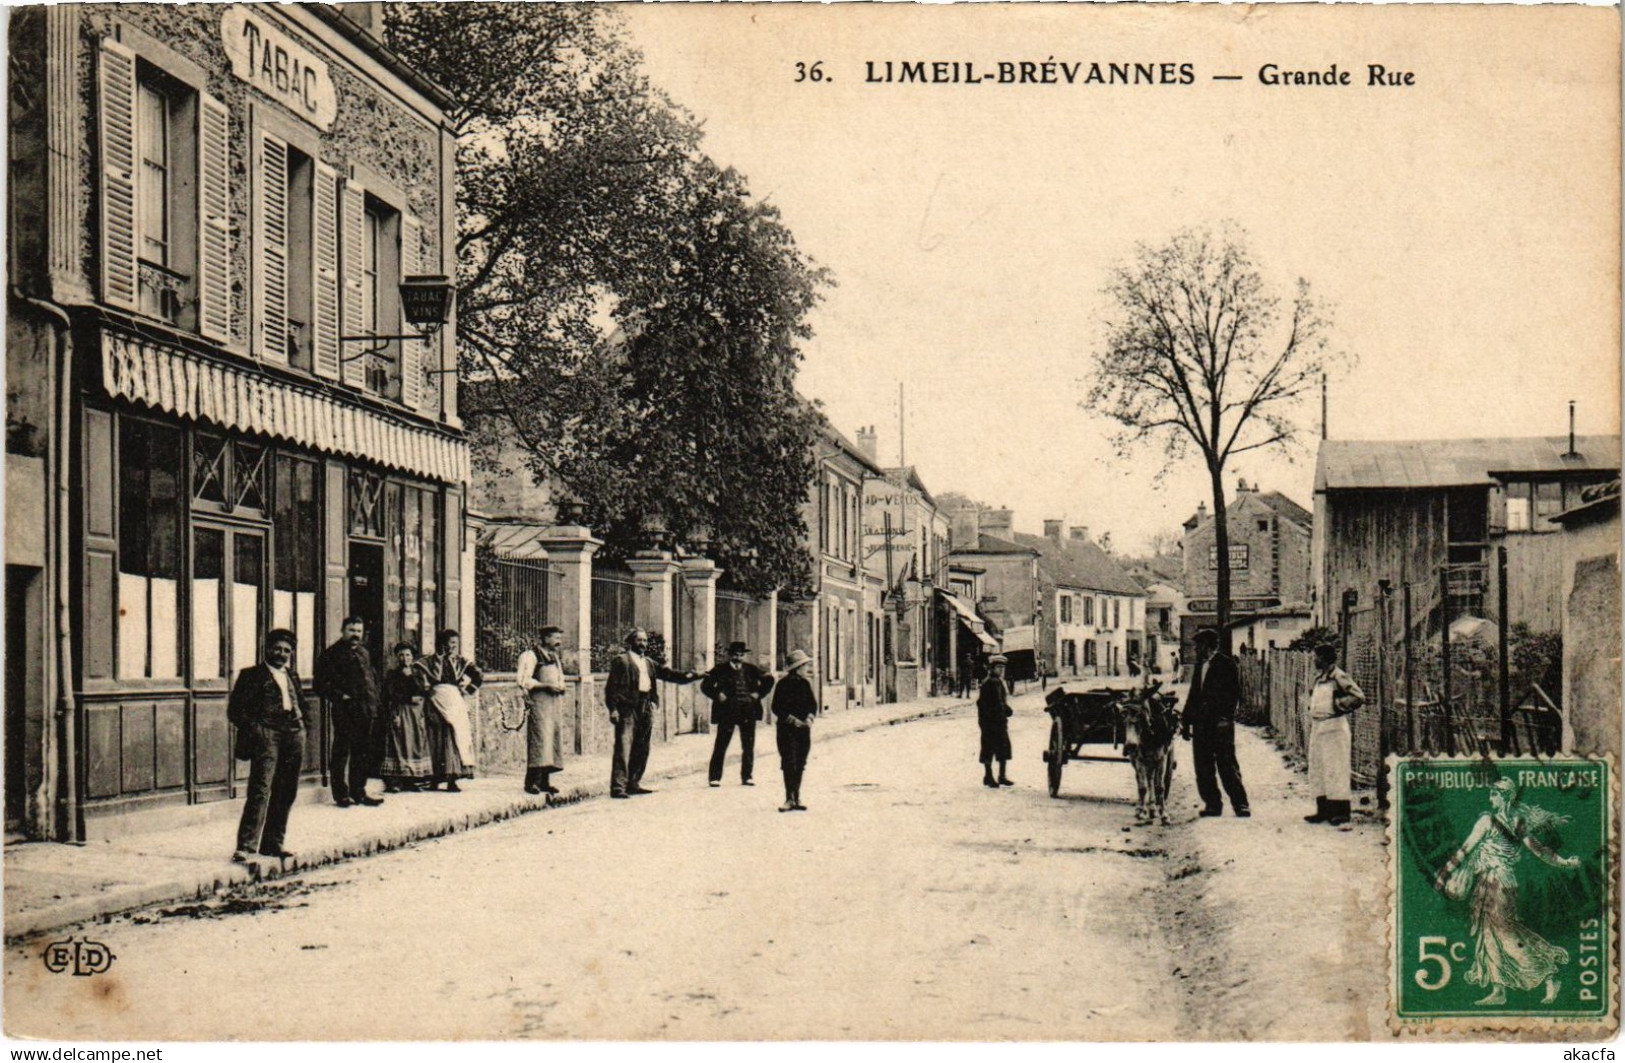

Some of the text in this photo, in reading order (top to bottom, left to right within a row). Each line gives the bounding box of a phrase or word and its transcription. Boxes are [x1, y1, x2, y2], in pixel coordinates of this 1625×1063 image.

[242, 18, 318, 114] TABAC
[406, 290, 443, 302] TABAC
[411, 305, 440, 317] VINS
[1518, 770, 1598, 791] FRANÇAISE
[1579, 917, 1599, 1001] POSTES
